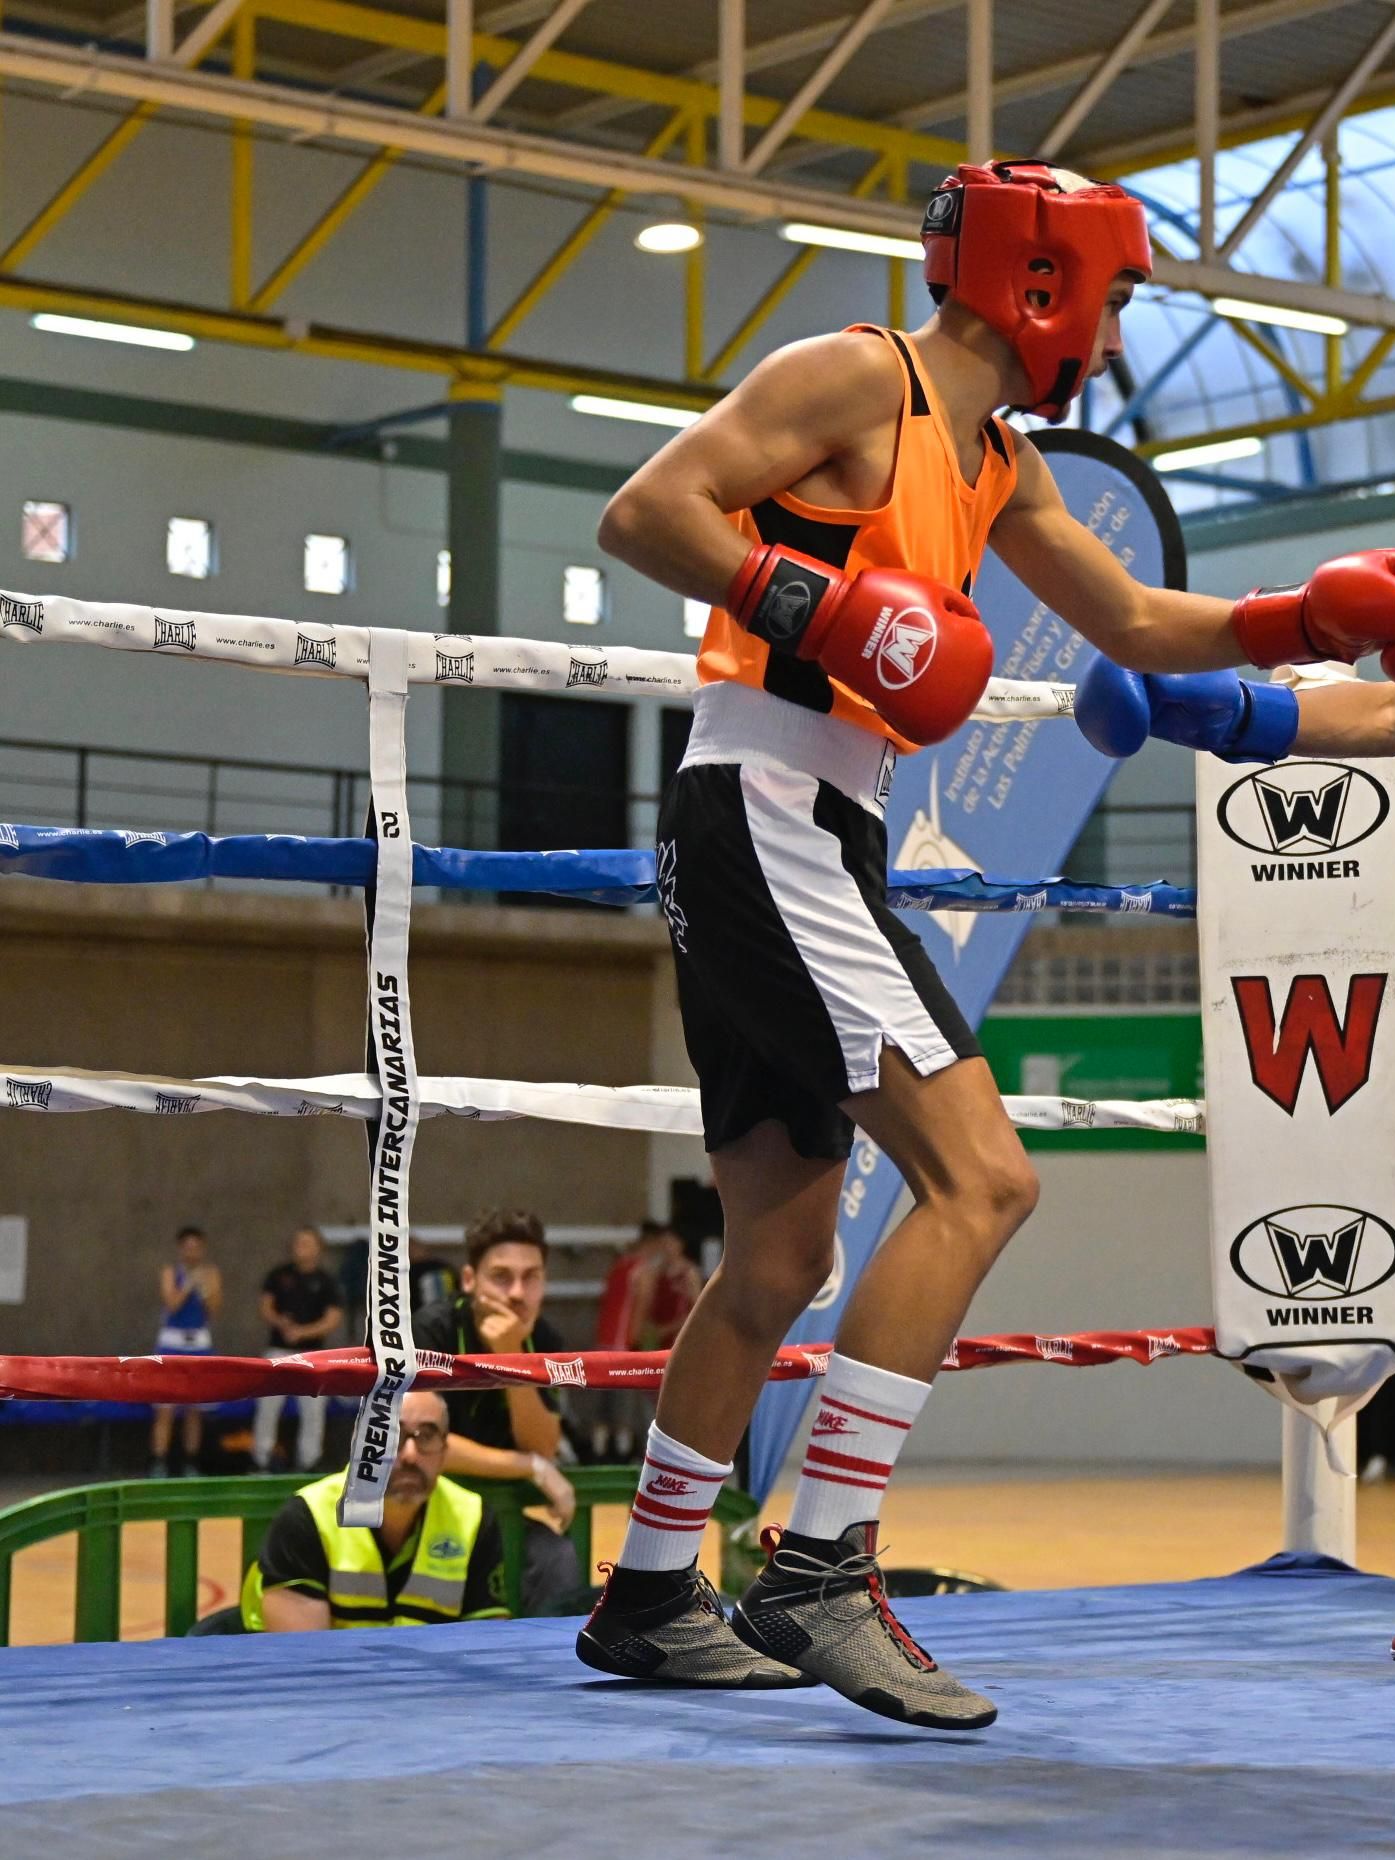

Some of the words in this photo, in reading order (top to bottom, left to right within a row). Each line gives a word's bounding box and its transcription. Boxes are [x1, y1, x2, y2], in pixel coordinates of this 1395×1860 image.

[68, 618, 136, 632] www.charlie.es
[154, 616, 197, 650] CHARLIE
[215, 636, 276, 650] www.charlie.es
[295, 635, 338, 667] CHARLIE
[861, 606, 893, 659] WINNER
[435, 652, 475, 682] CHARLIE
[493, 666, 551, 676] www.charlie.es
[567, 660, 609, 687] CHARLIE
[988, 776, 1013, 811] Las
[1251, 771, 1353, 852] W
[1250, 859, 1361, 882] WINNER
[1230, 972, 1388, 1118] W
[377, 971, 410, 1225] INTERCANARIAS
[1263, 1214, 1367, 1296] W
[377, 1231, 404, 1351] BOXING
[1266, 1306, 1374, 1326] WINNER
[415, 1350, 455, 1376] HARLIE
[544, 1357, 588, 1389] CHARLIE
[356, 1357, 407, 1485] PREMIER
[655, 1474, 689, 1490] NIKE
